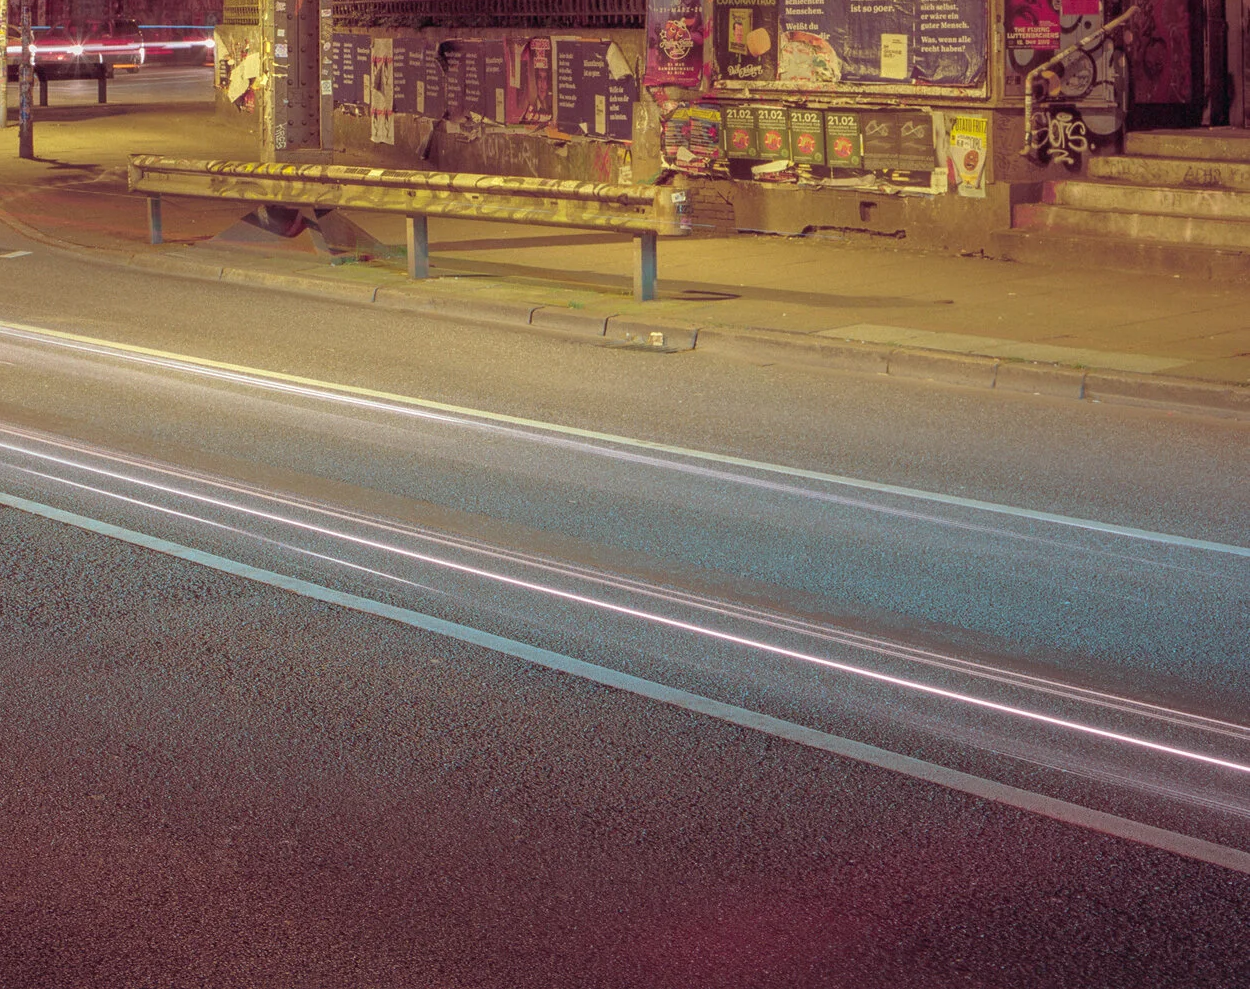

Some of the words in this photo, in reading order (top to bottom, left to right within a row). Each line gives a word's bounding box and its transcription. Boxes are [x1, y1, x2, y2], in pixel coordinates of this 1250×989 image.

[785, 7, 824, 15] Menschen.
[850, 5, 862, 13] ist
[873, 4, 895, 14] 90er.
[936, 3, 959, 11] selbst,
[930, 12, 947, 20] wäre
[786, 22, 808, 30] Weißt
[808, 22, 819, 30] du
[920, 23, 940, 31] guter
[940, 22, 970, 30] Mensch.
[921, 35, 938, 43] Was,
[957, 35, 972, 43] alle
[921, 45, 940, 53] recht
[941, 45, 966, 53] haben?
[726, 109, 754, 119] 21.02.
[758, 110, 786, 120] 21.02.
[791, 112, 820, 123] 21.02.
[827, 115, 857, 126] 21.02.
